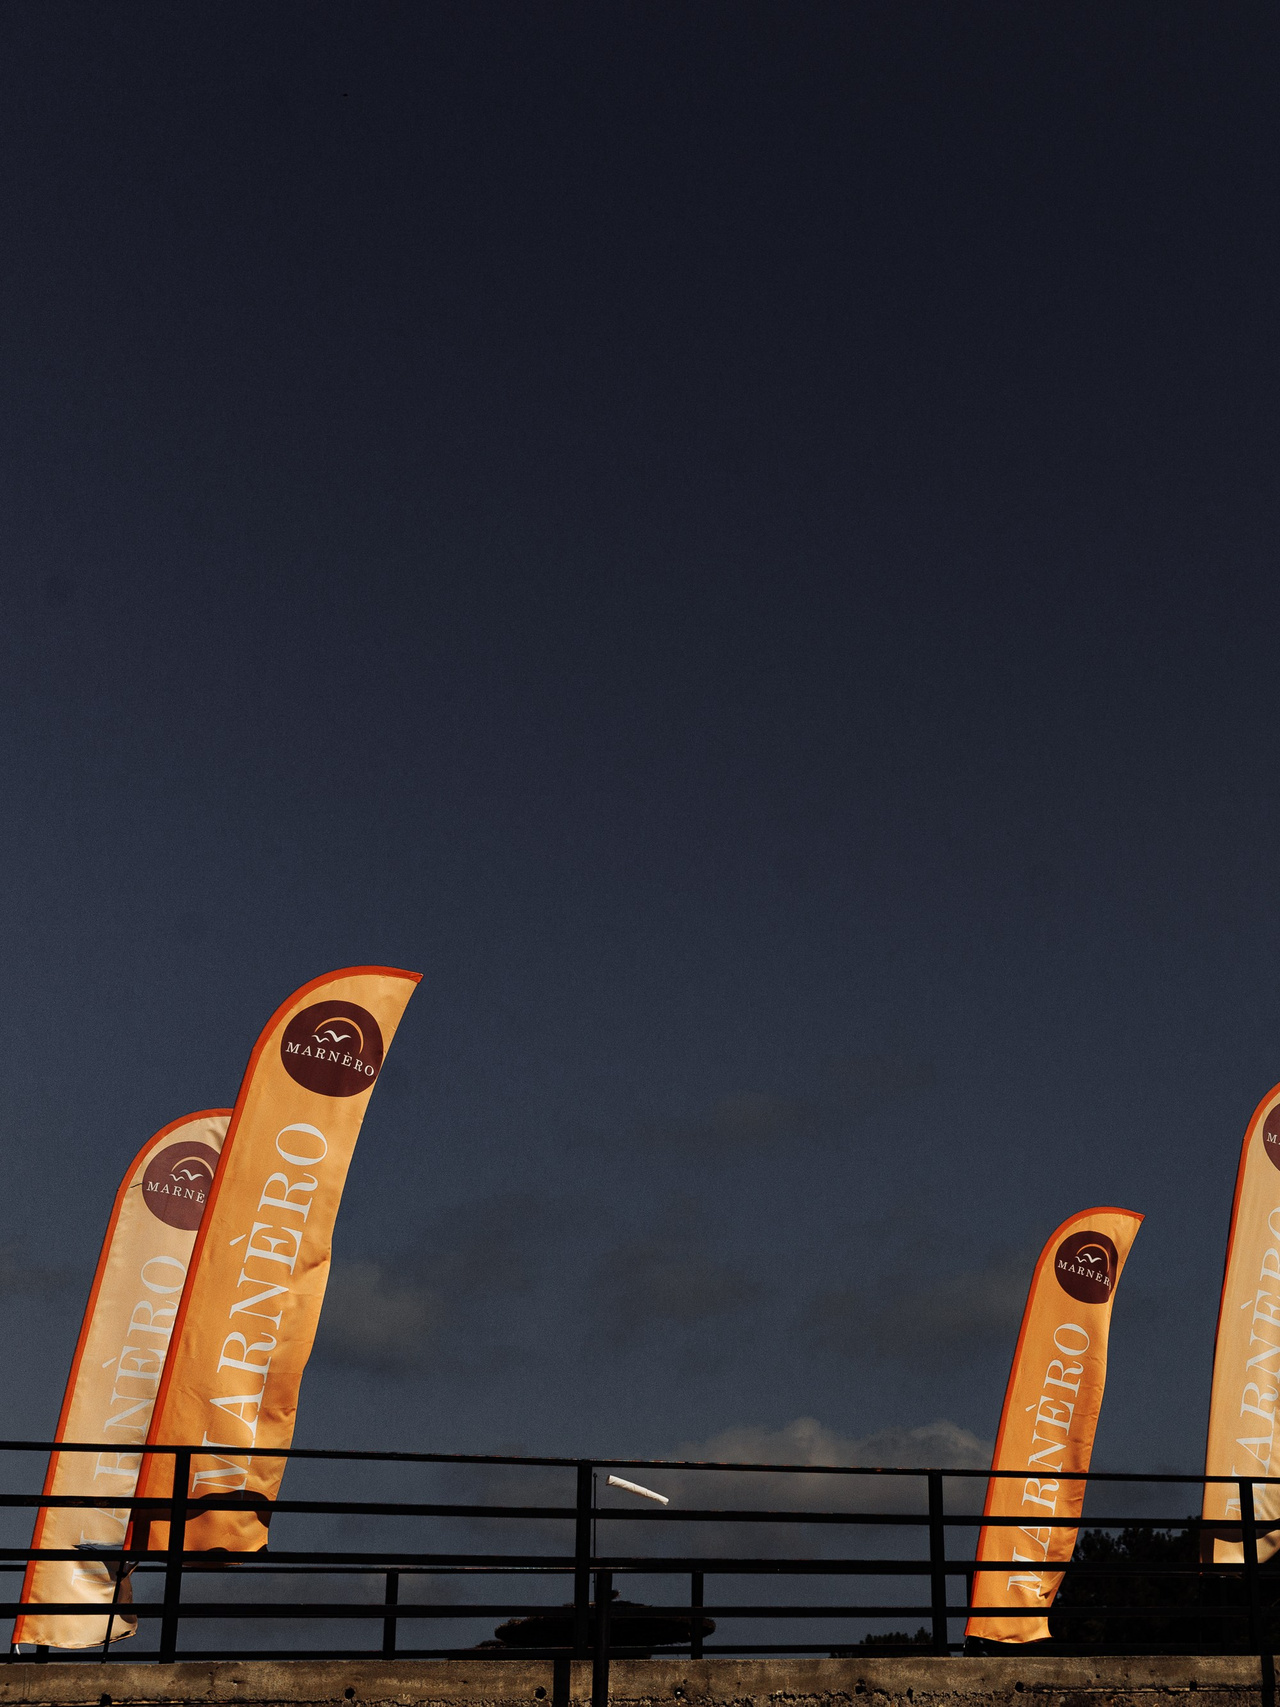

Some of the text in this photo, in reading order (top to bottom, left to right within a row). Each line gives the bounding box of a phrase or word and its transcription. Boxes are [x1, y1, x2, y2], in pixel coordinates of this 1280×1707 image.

[285, 1041, 376, 1078] MARNÈRO
[146, 1180, 206, 1204] MARNÈ
[191, 1122, 328, 1499] MARNÈRO
